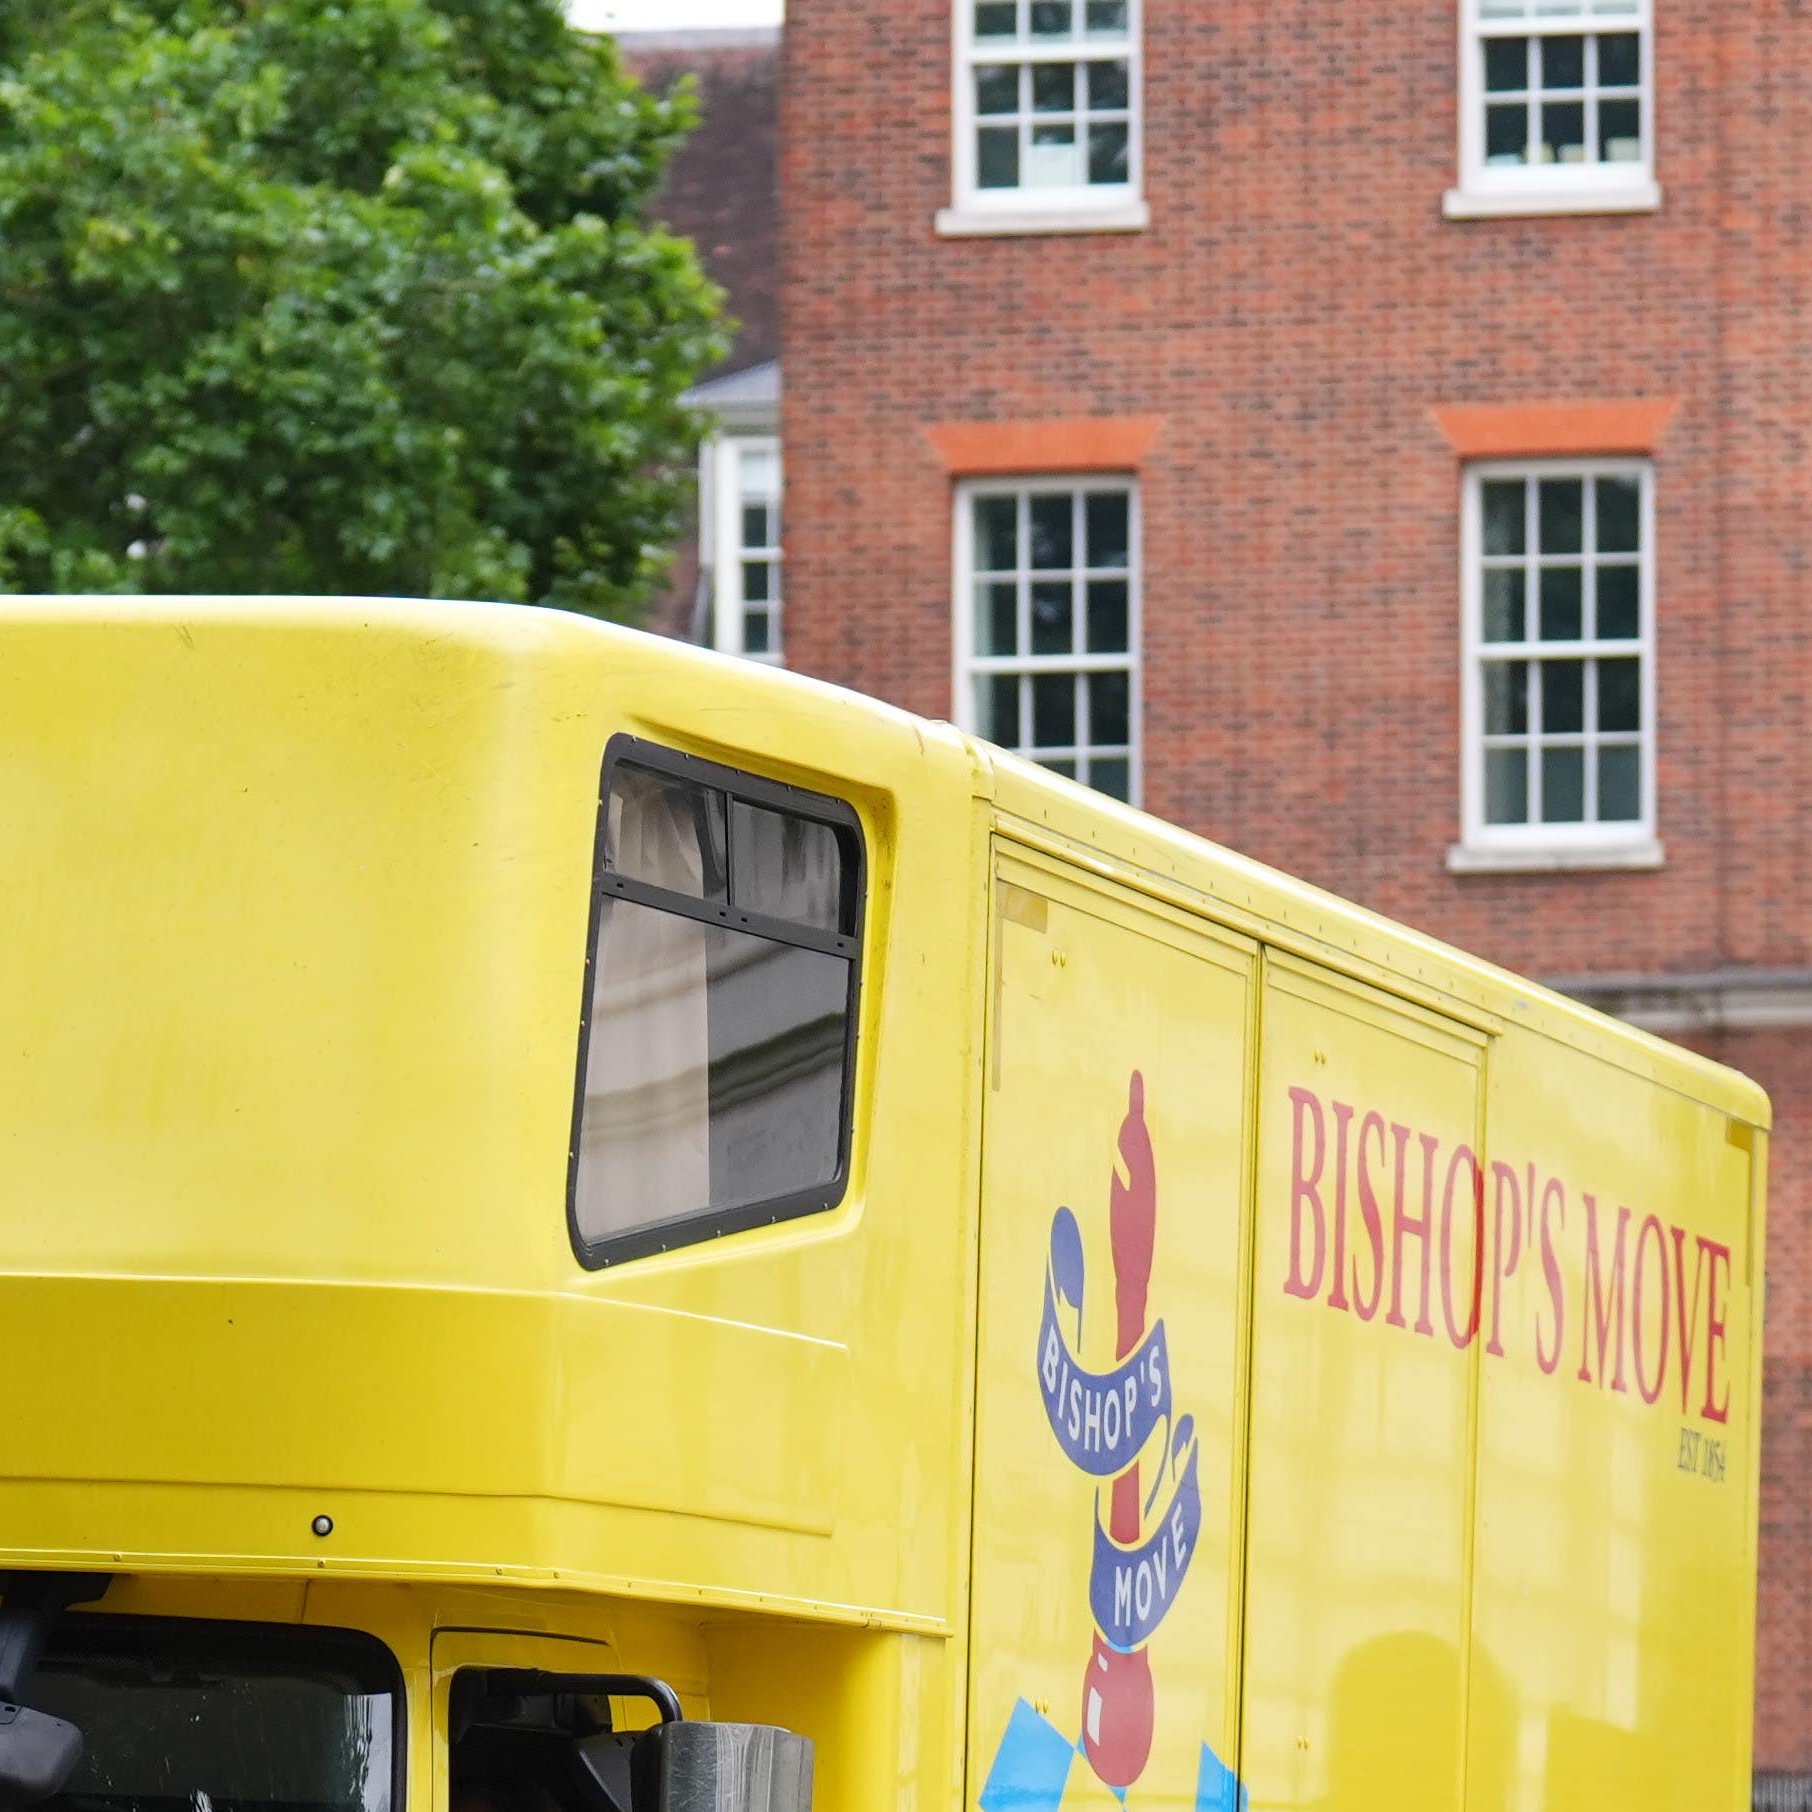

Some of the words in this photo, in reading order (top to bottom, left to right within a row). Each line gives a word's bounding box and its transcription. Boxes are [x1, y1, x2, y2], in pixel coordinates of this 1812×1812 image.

[1284, 1086, 1564, 1374] BISHOP'S
[1578, 1193, 1731, 1424] MOVE
[1043, 1324, 1162, 1452] BISHOP'S
[1114, 1501, 1186, 1627] MOVE
